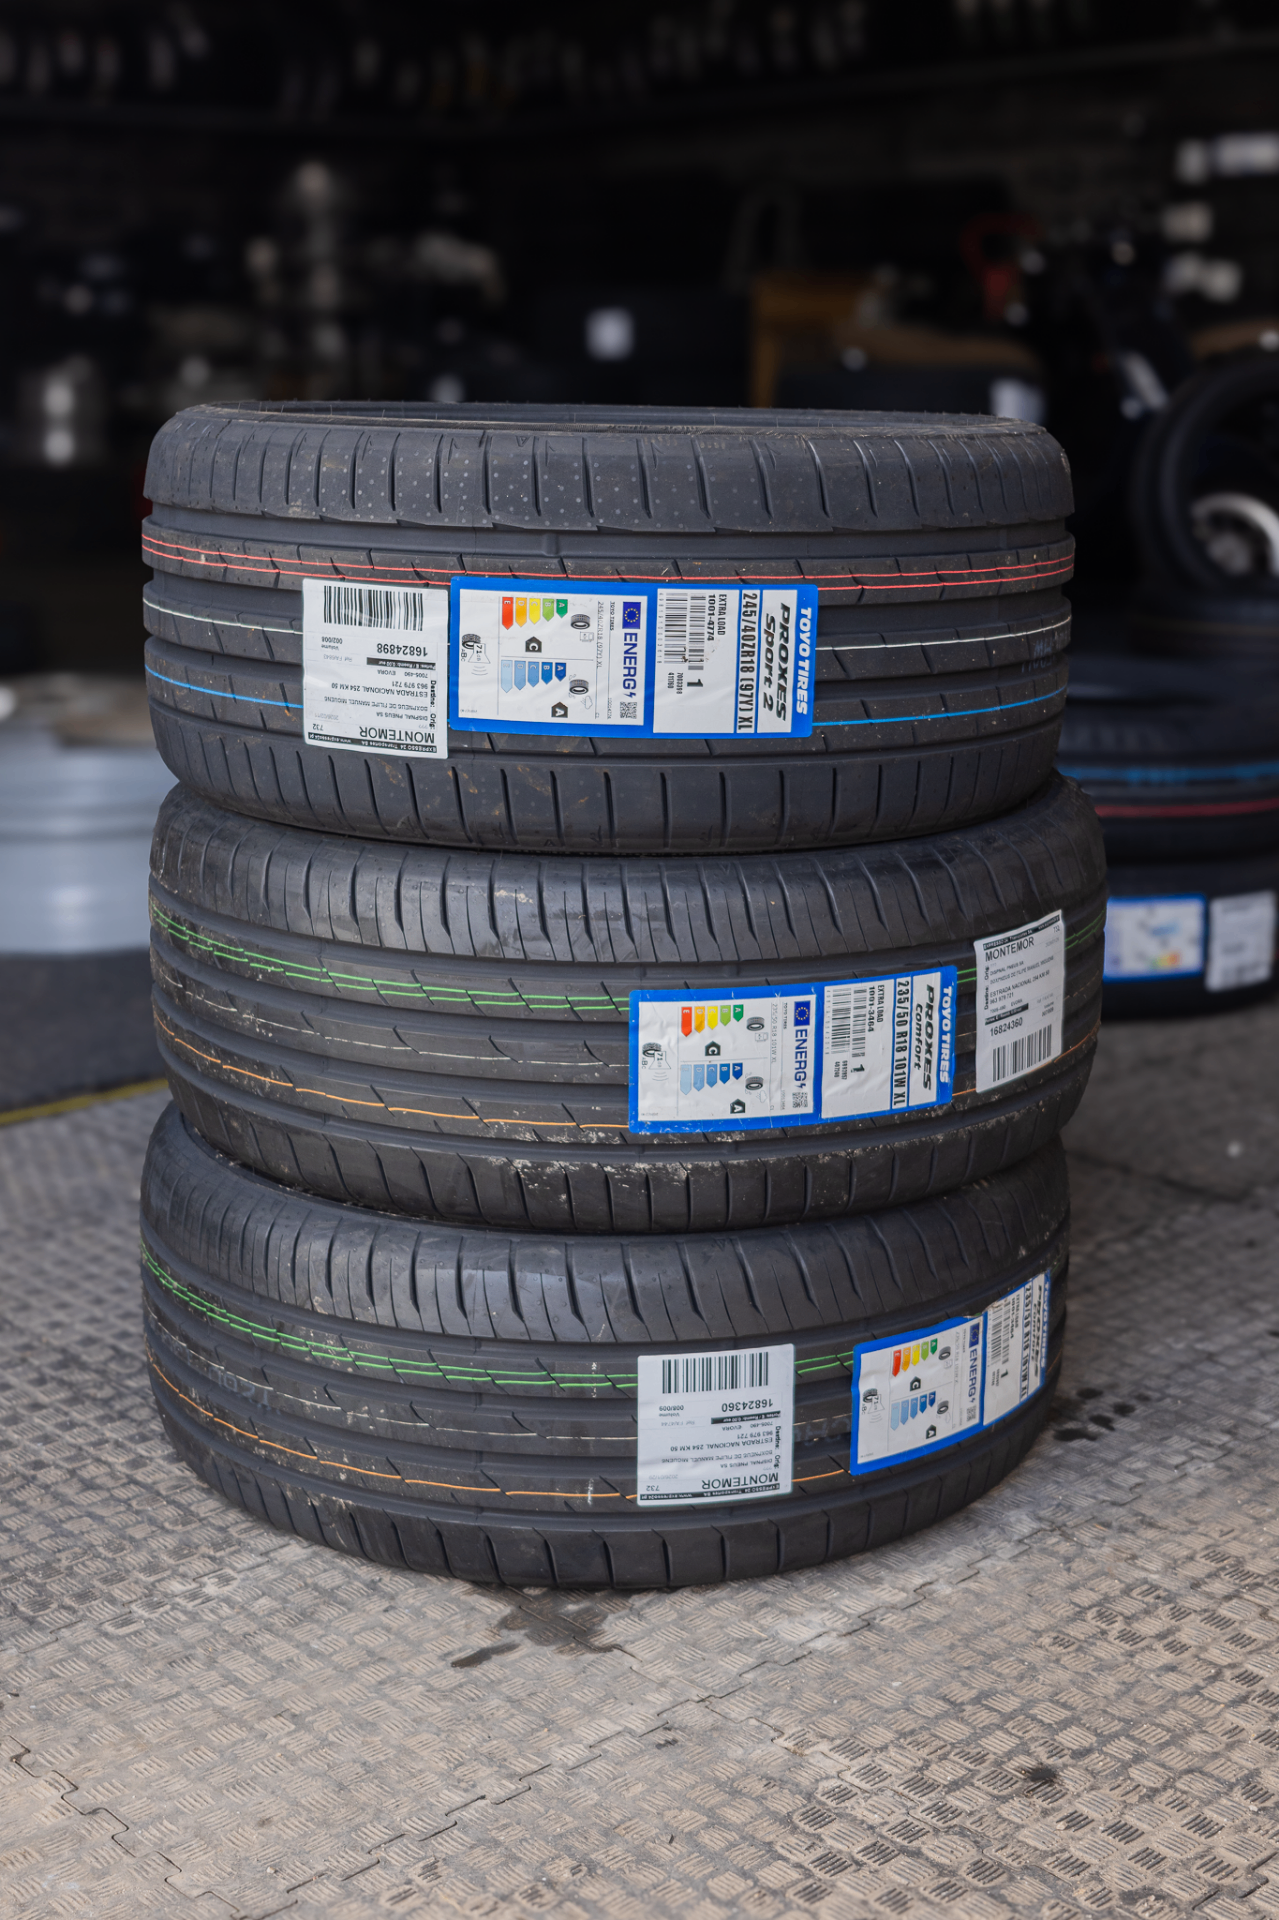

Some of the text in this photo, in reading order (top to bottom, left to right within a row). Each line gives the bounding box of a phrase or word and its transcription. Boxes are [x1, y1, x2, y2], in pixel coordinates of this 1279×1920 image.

[707, 594, 716, 641] 1001-4774
[717, 594, 727, 635] EXTRA LOAD
[376, 643, 428, 657] 16824898
[529, 643, 539, 651] C
[597, 661, 603, 669] XL
[622, 633, 637, 690] ENERG
[738, 593, 757, 730] 245/40ZR18 (97Y) XL
[762, 613, 776, 712] Sport 2
[776, 603, 790, 721] PROXES
[796, 607, 811, 715] TOYO TIRES
[362, 686, 394, 695] NACIONAL
[687, 679, 703, 687] 1
[397, 689, 427, 698] ESTRADA
[555, 708, 564, 717] A
[313, 723, 323, 731] 732
[359, 726, 434, 745] MONTEMOR
[985, 937, 1034, 962] MONTEMOR
[990, 977, 1032, 997] ESTRADA NACIONAL
[867, 986, 875, 1033] 1001-3464
[940, 986, 952, 1084] TOYO TIRES
[990, 1017, 1023, 1036] 16824360
[894, 980, 909, 1106] 235/50 R18 101W XL
[922, 983, 935, 1092] PROXES
[794, 1029, 807, 1082] ENERG
[851, 1063, 865, 1073] 1
[734, 1104, 742, 1113] A
[968, 1348, 978, 1398] ENERG
[721, 1398, 773, 1412] 16824360
[706, 1441, 740, 1449] NACIONAL
[742, 1437, 772, 1446] ESTRADA
[701, 1472, 778, 1490] MONTEMOR
